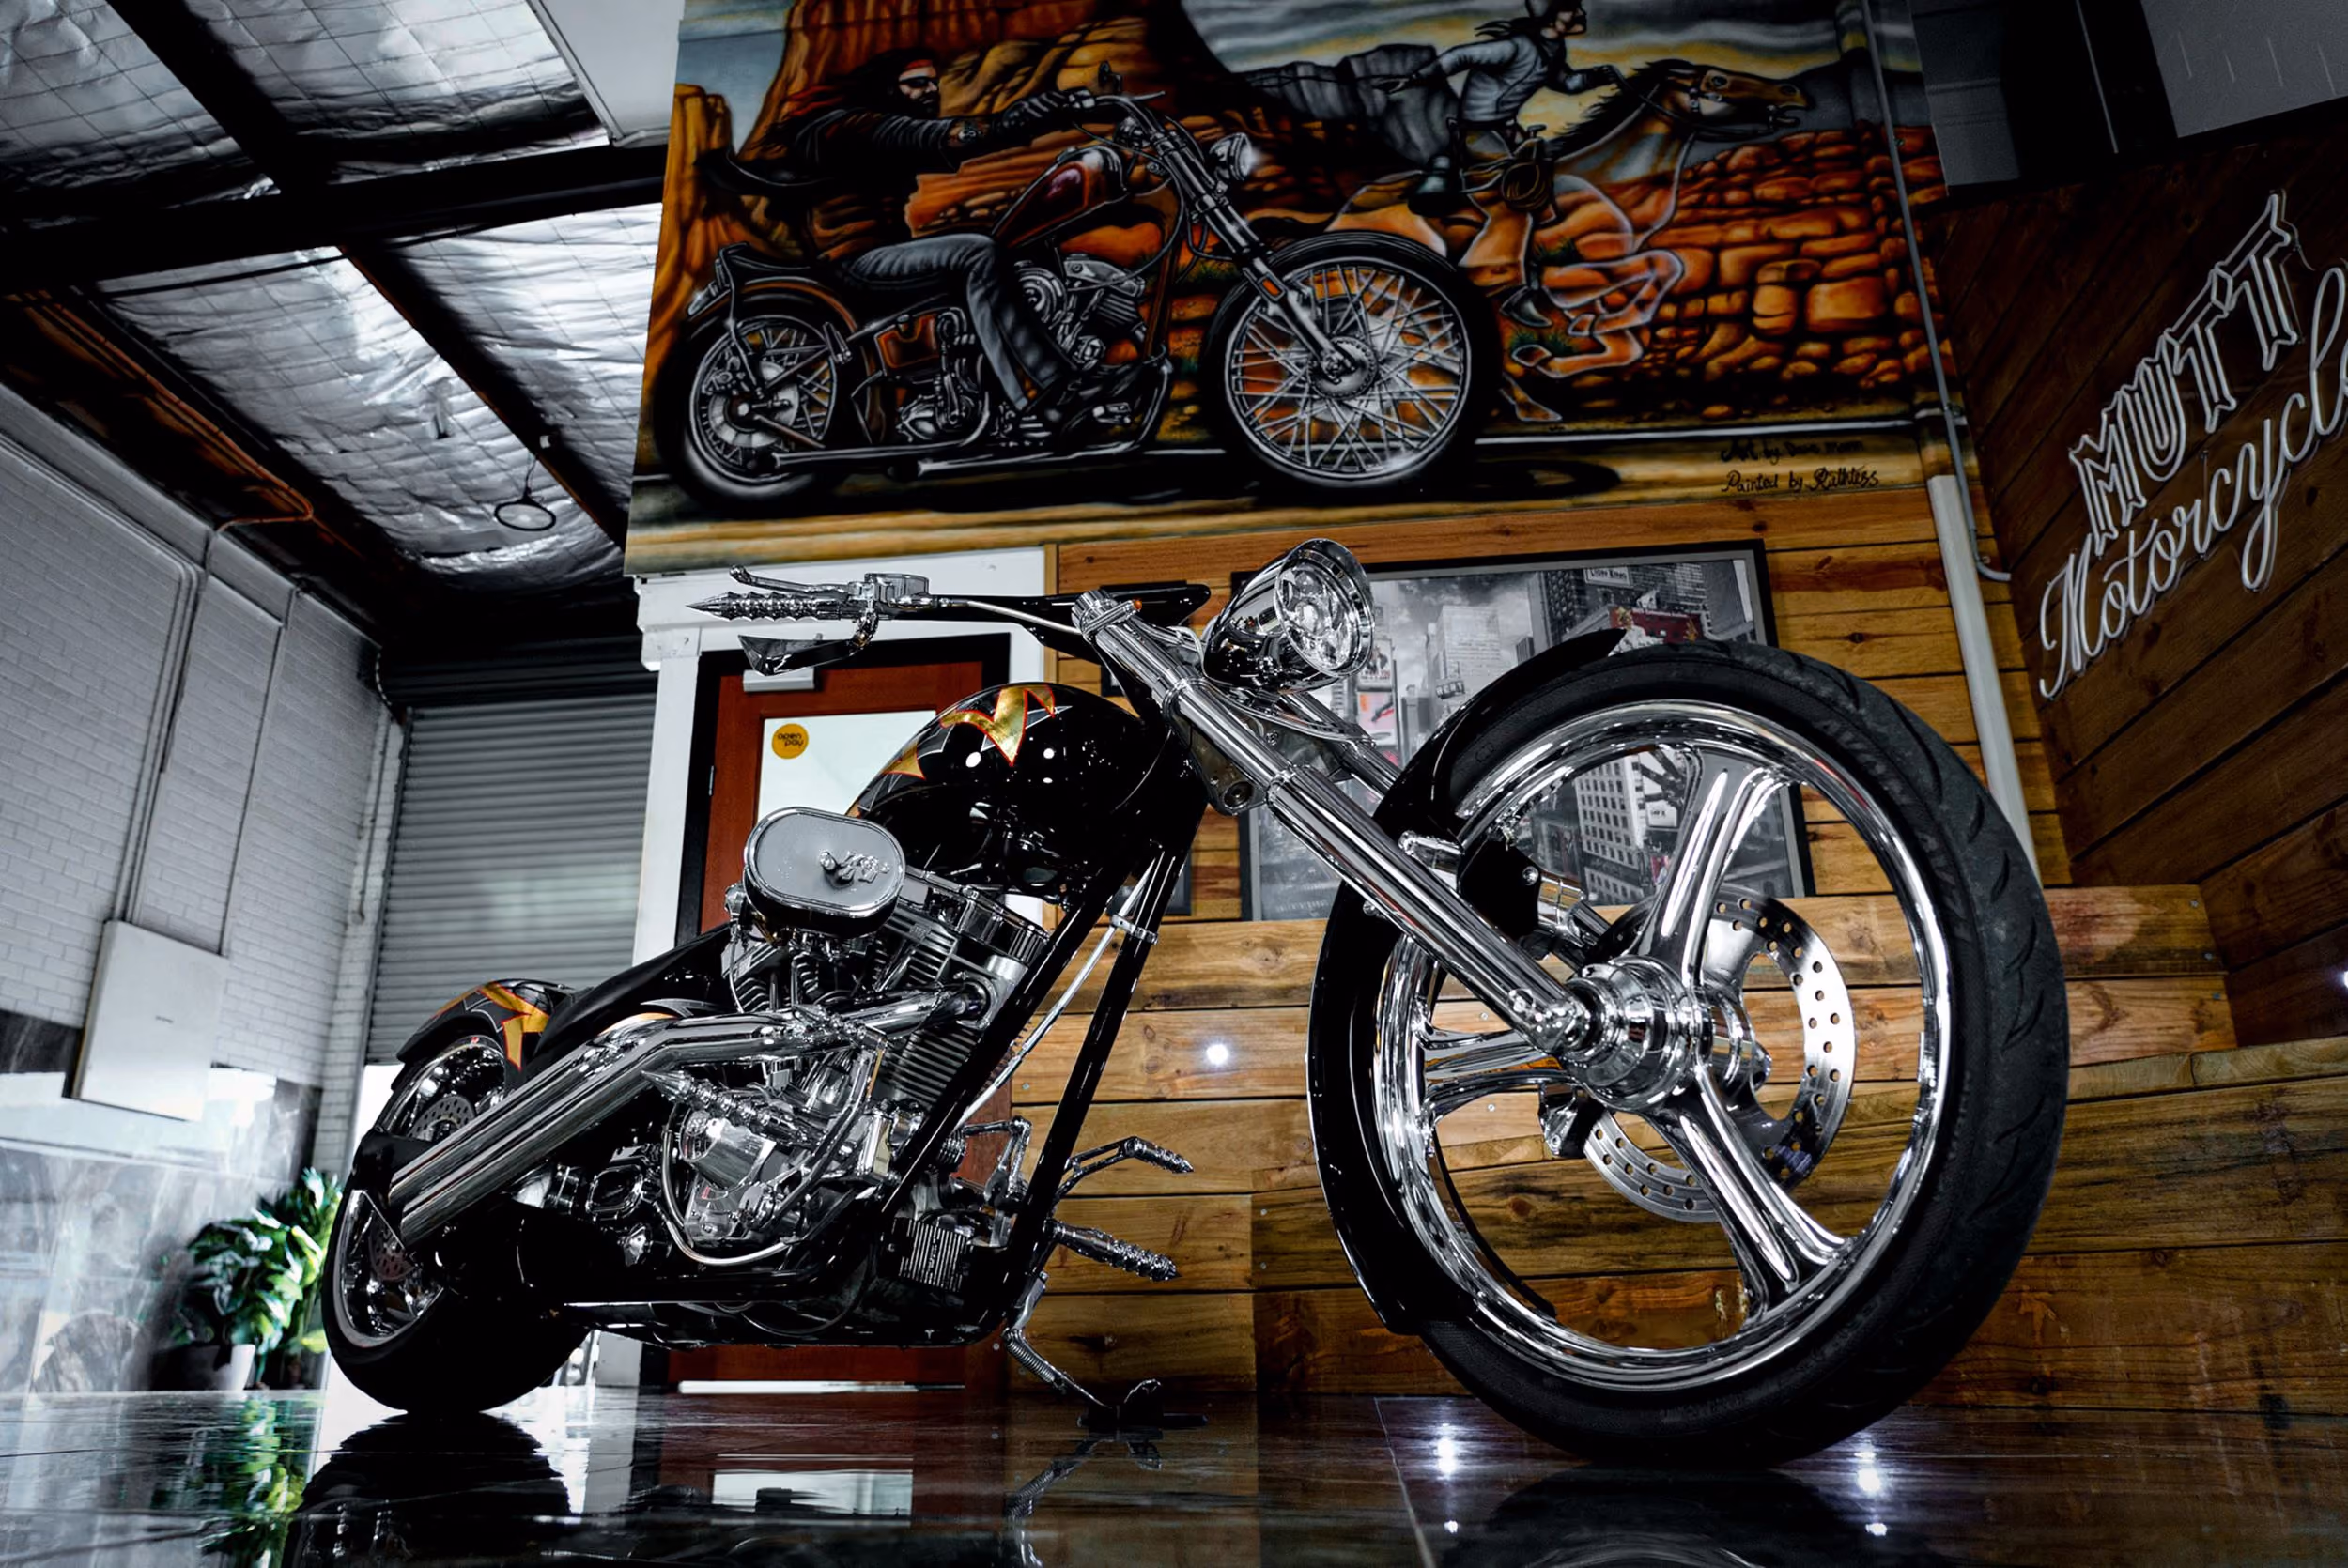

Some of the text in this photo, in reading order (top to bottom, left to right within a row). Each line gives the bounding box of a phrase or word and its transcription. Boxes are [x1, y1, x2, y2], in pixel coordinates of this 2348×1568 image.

[2068, 192, 2298, 556] MUTT
[1763, 439, 1780, 465] by
[1721, 465, 1879, 493] Painted by Ruthless
[2039, 268, 2348, 699] Motorcycl
[778, 732, 802, 741] open
[784, 739, 804, 747] pay
